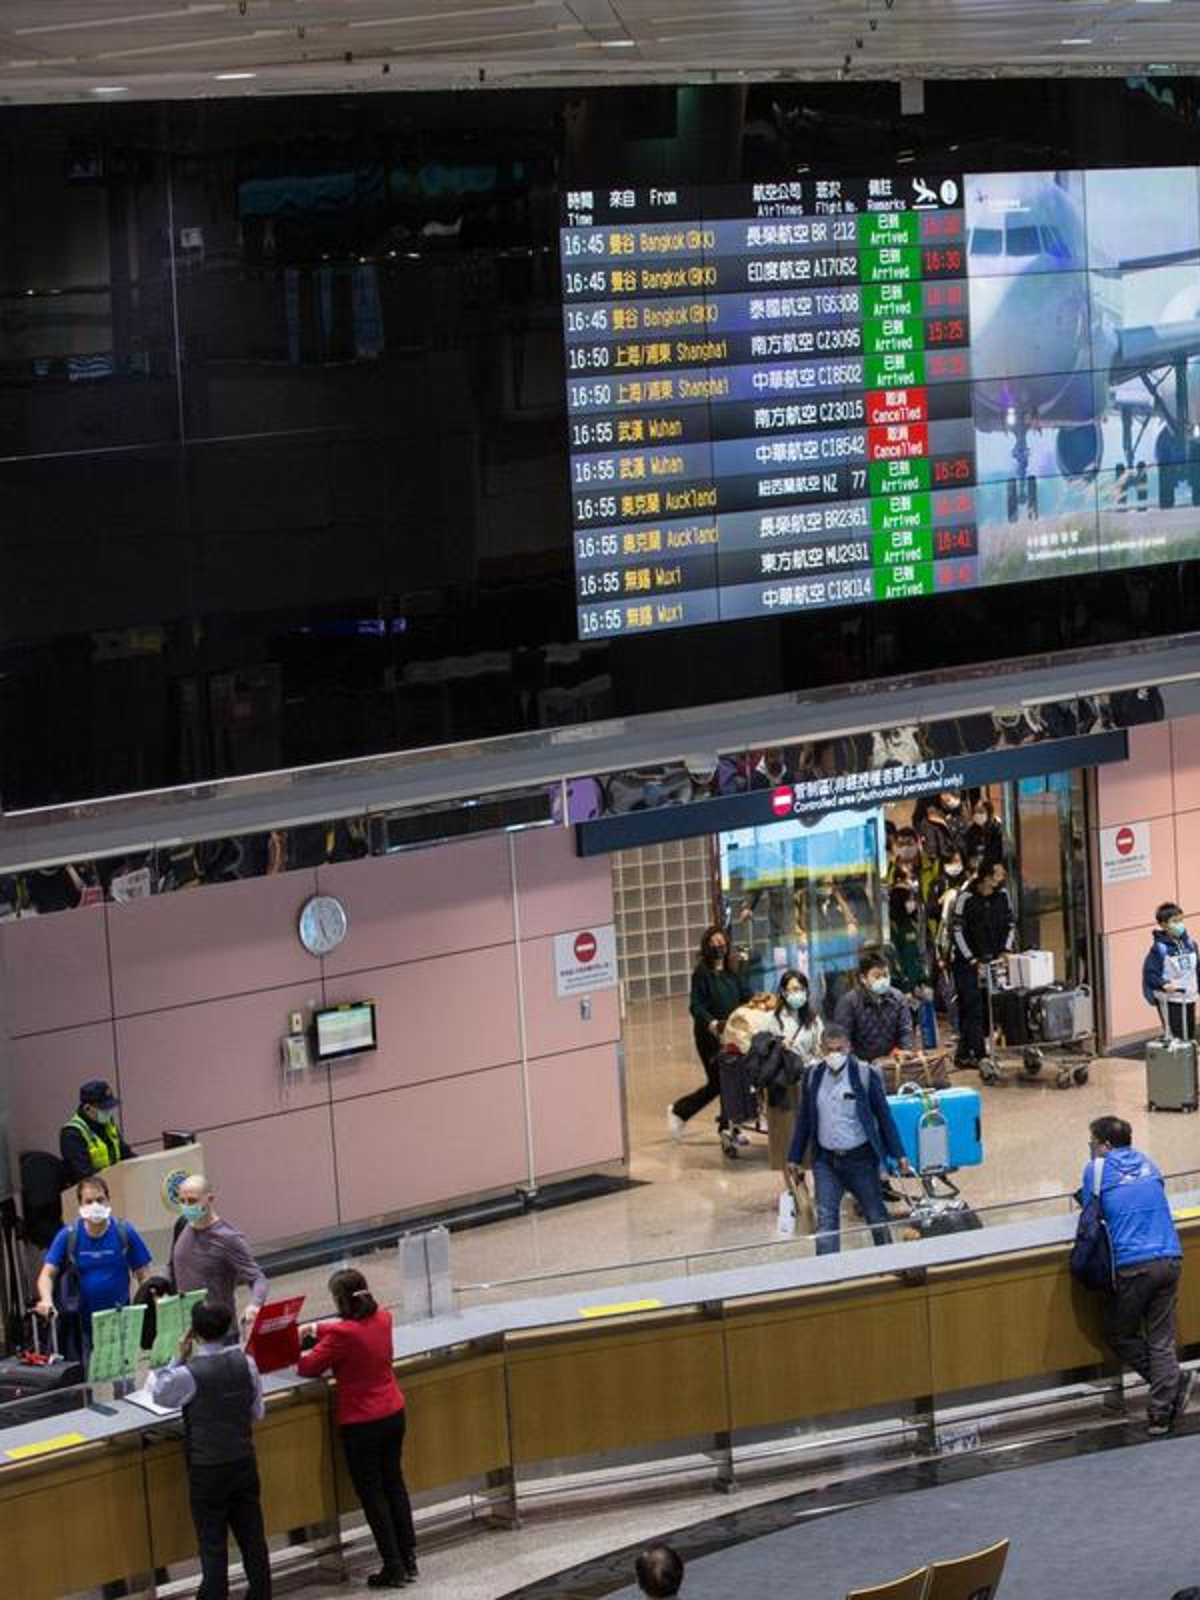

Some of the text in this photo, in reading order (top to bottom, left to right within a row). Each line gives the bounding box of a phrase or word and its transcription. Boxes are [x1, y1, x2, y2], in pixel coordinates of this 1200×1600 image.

[566, 191, 593, 209] 時間
[609, 190, 635, 207] 來自
[649, 189, 677, 205] From
[752, 182, 801, 201] 航空公司
[568, 213, 593, 226] Time
[757, 203, 803, 216] Airlines
[564, 234, 604, 255] 16:45
[746, 224, 809, 246] 長榮航空
[811, 223, 826, 242] BR
[832, 221, 856, 241] 212
[870, 230, 908, 245] Arrived
[565, 272, 606, 293] 16:45
[871, 266, 910, 280] Arrived
[872, 301, 911, 316] Arrived
[567, 309, 607, 331] 16:45
[569, 347, 609, 369] 16:50
[676, 339, 726, 364] Shanghai
[751, 332, 814, 355] 南方航空
[874, 336, 913, 352] Arrived
[570, 384, 611, 407] 16:50
[677, 376, 728, 401] Shanghai
[752, 368, 815, 392] 中華航空
[875, 371, 914, 387] Arrived
[572, 422, 612, 445] 16:55
[617, 419, 643, 442] 武漢
[649, 417, 682, 438] Wuhan
[754, 404, 817, 428] 南方航空
[872, 406, 921, 423] Cancelled
[574, 460, 614, 482] 16:55
[618, 456, 645, 480] 武漢
[650, 454, 684, 475] Wuhan
[756, 440, 818, 464] 中華航空
[873, 441, 922, 459] Cancelled
[576, 497, 616, 520] 16:55
[665, 487, 717, 511] Auckland
[822, 473, 837, 493] NZ
[851, 470, 866, 490] 77
[880, 477, 918, 493] Arrived
[881, 512, 920, 528] Arrived
[577, 534, 617, 558] 16:55
[667, 524, 718, 548] Auckland
[759, 511, 821, 537] 長榮航空
[882, 547, 921, 564] Arrived
[579, 572, 619, 596] 16:55
[655, 565, 681, 587] Wuxi
[760, 547, 823, 573] 東方航空
[884, 582, 922, 599] Arrived
[581, 609, 621, 633] 16:55
[657, 602, 683, 624] Wuxi
[762, 583, 824, 609] 中華航空
[794, 774, 963, 813] Controlled area (Authorized personnel only)
